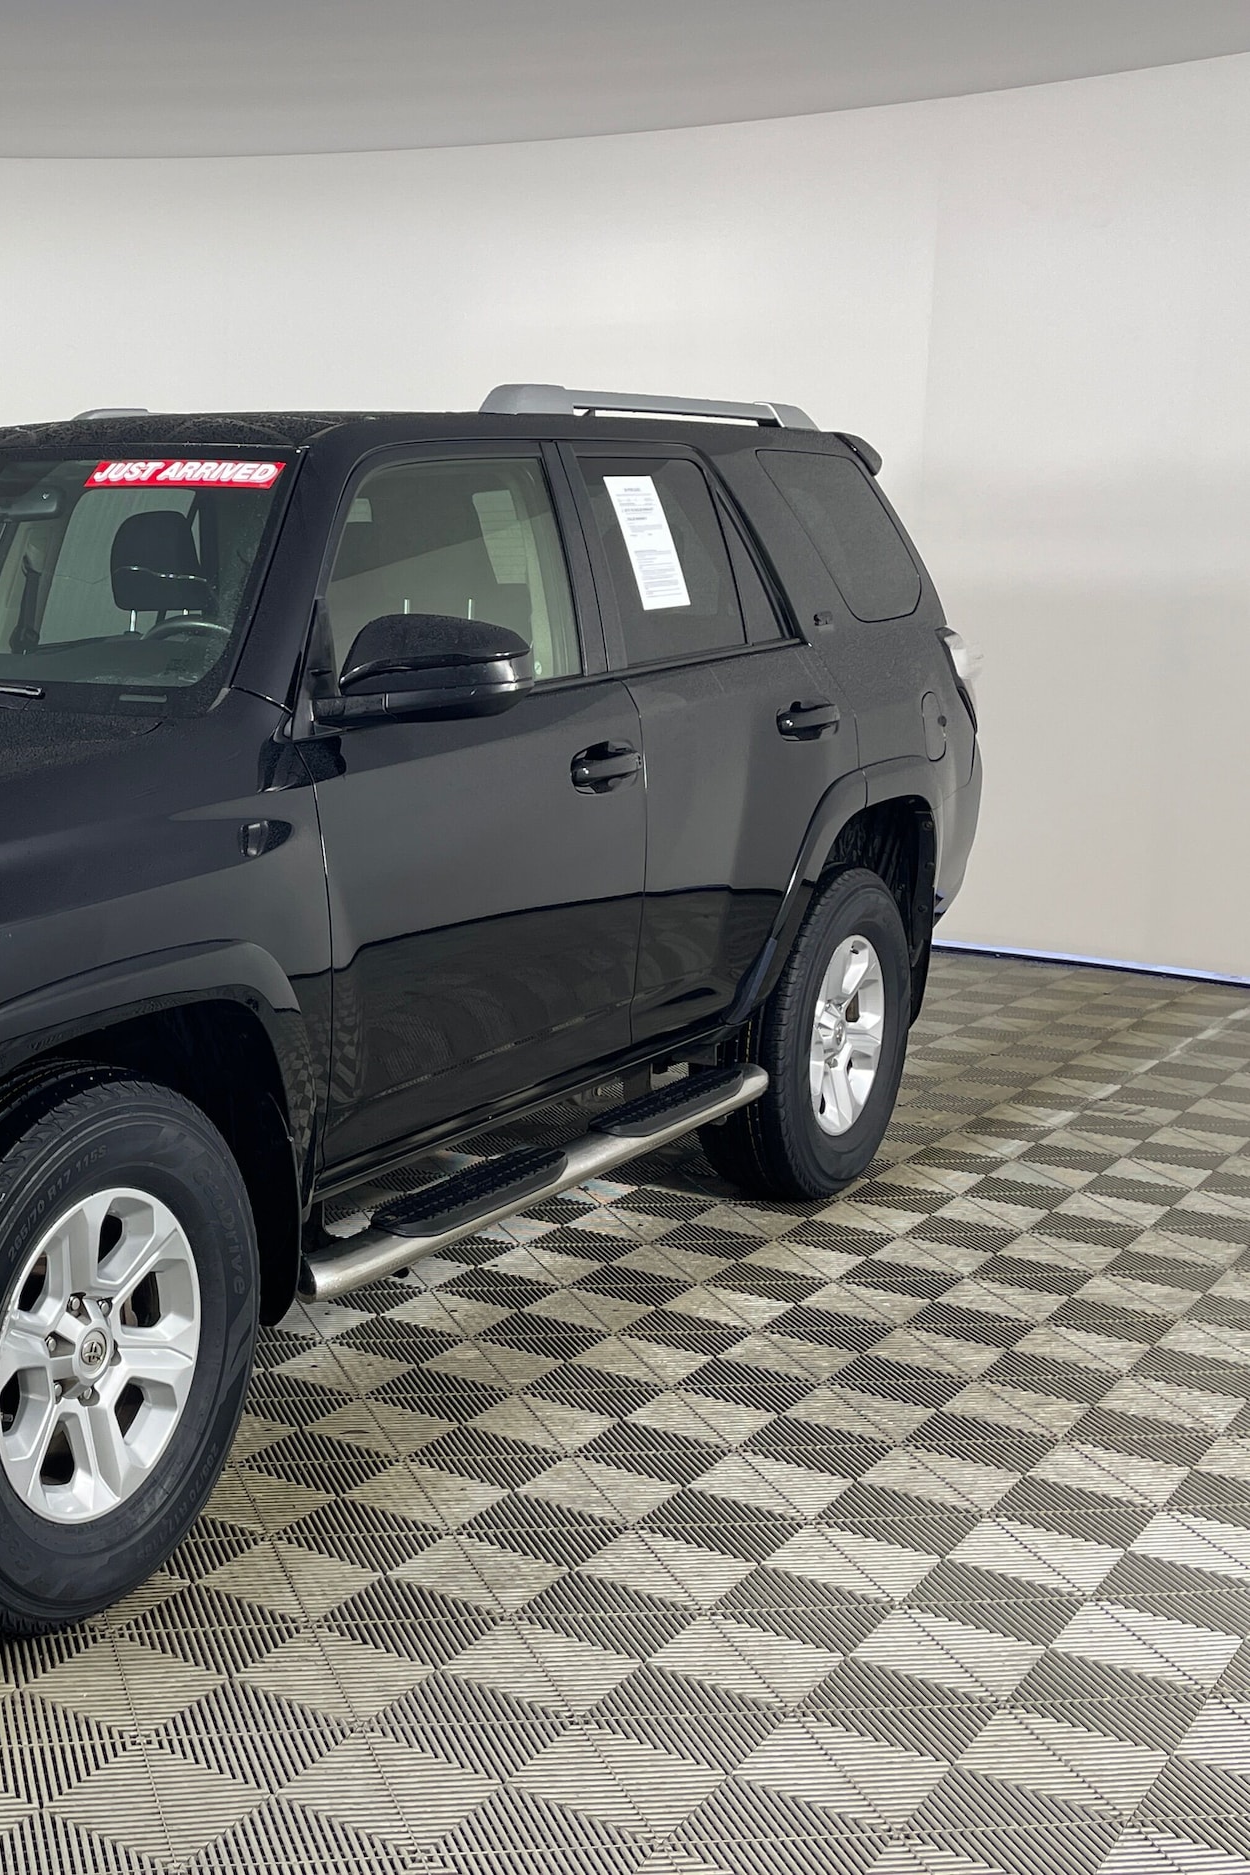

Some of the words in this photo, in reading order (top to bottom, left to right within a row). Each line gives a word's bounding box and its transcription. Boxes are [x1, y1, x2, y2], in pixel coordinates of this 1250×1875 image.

[94, 462, 165, 482] JUST
[156, 462, 279, 484] ARRIVED
[47, 1168, 71, 1201] R17
